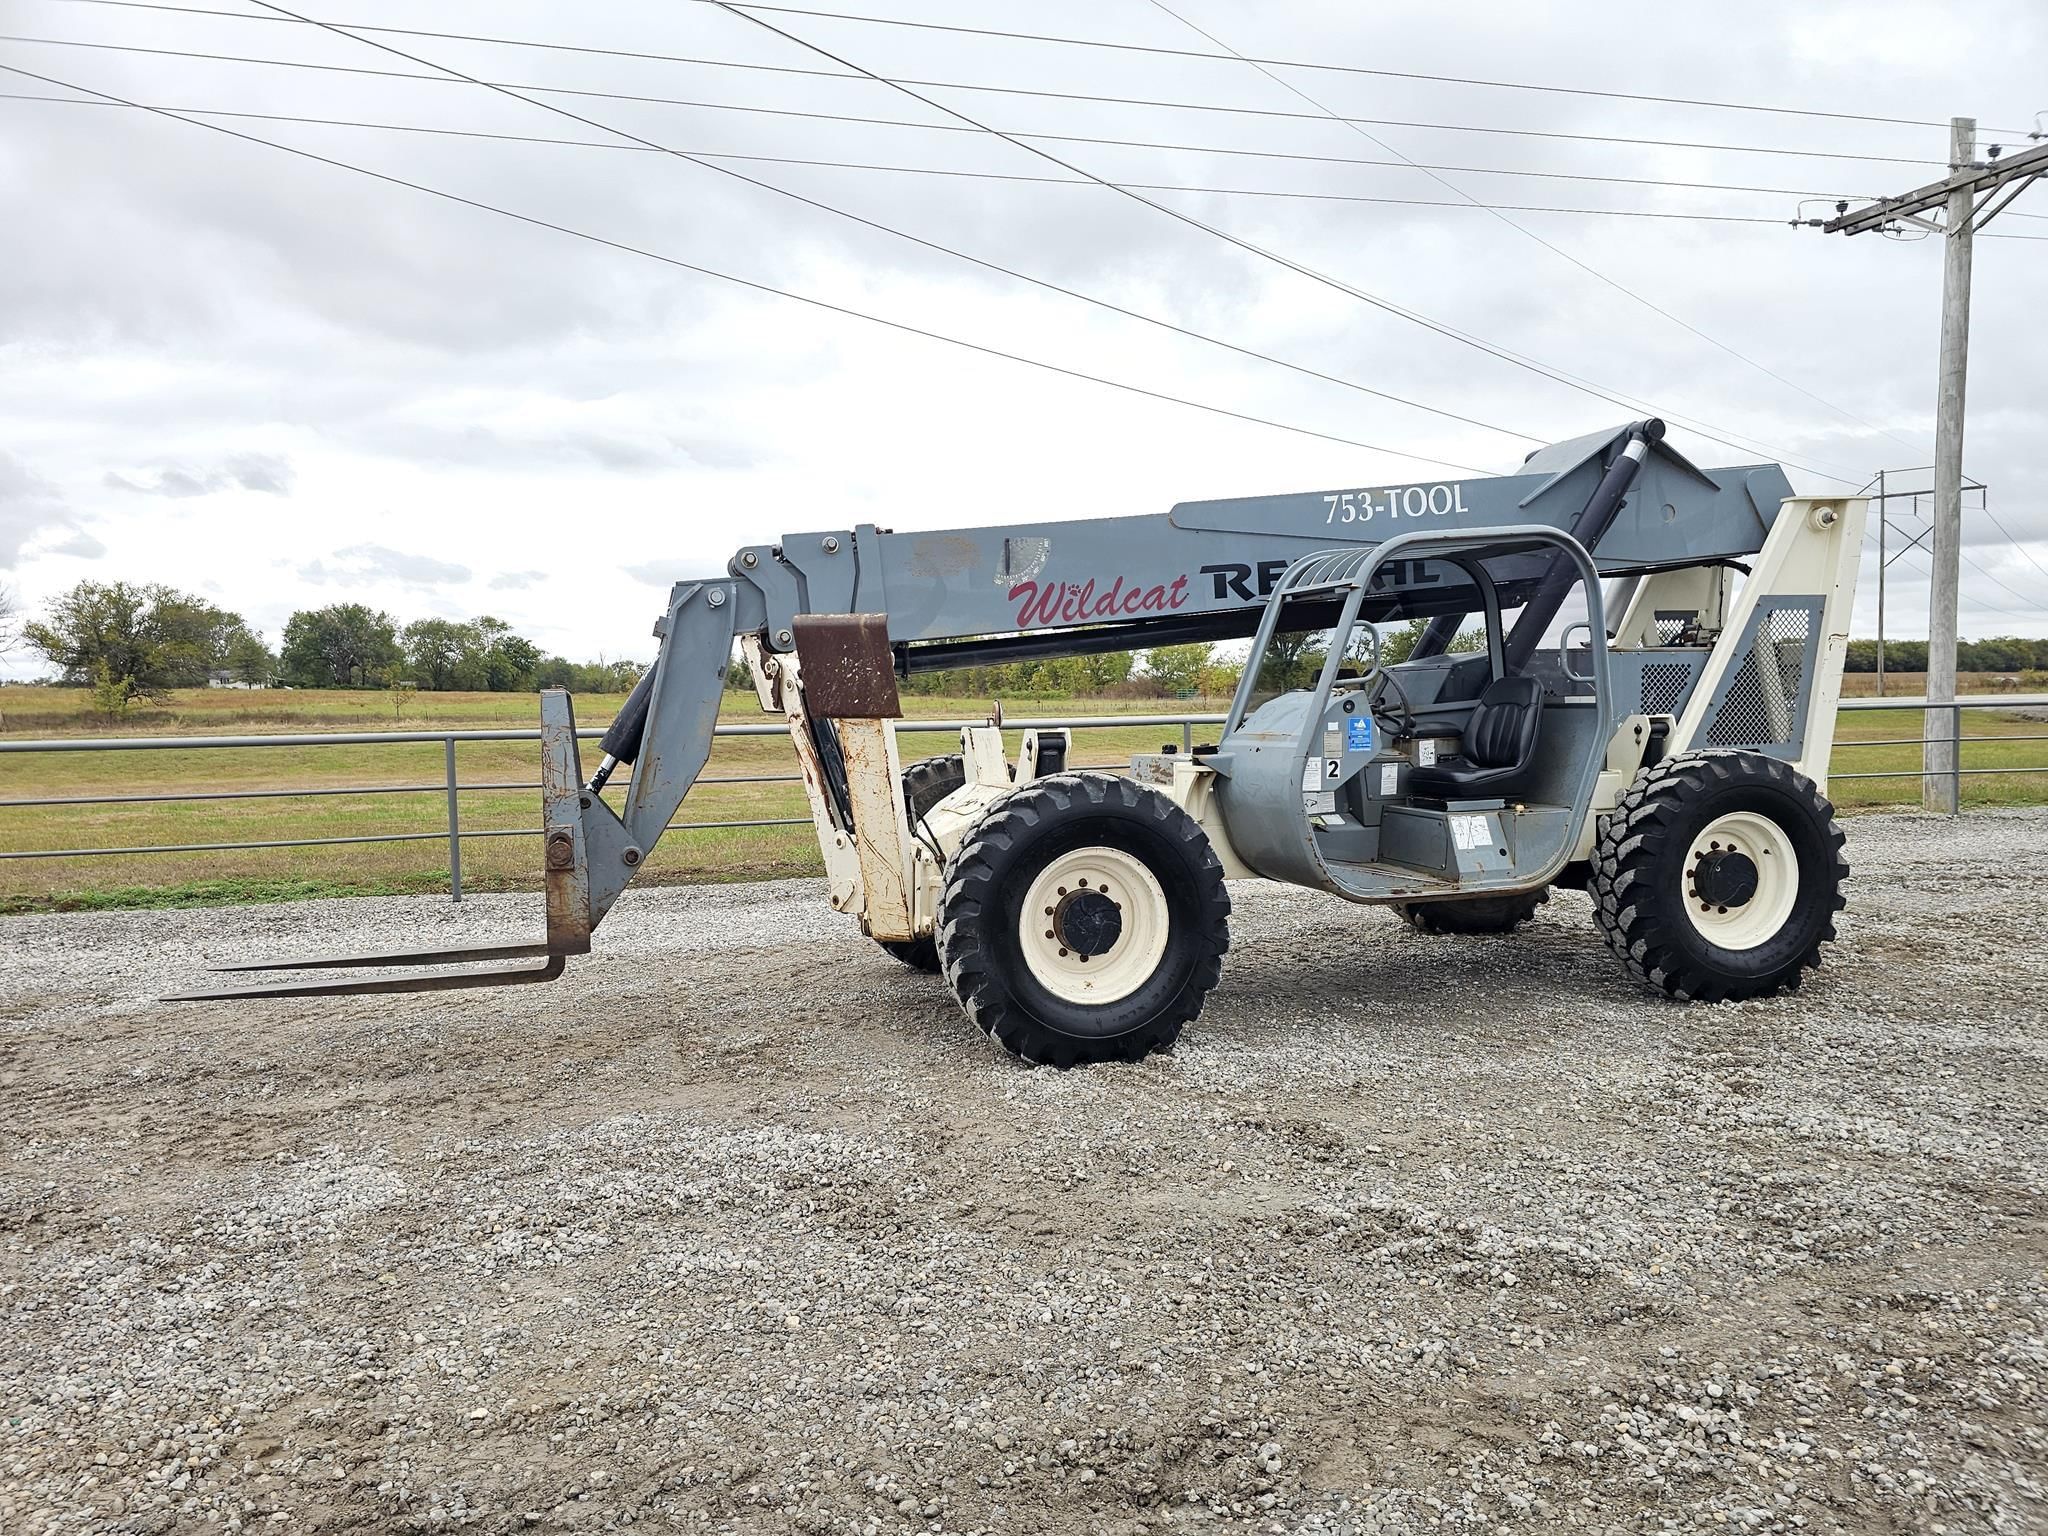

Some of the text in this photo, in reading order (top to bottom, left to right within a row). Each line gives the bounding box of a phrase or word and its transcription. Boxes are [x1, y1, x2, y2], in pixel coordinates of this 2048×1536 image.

[1323, 484, 1469, 524] 753-TOOL
[1008, 559, 1440, 628] Wildcat REAL
[1328, 760, 1339, 777] 2
